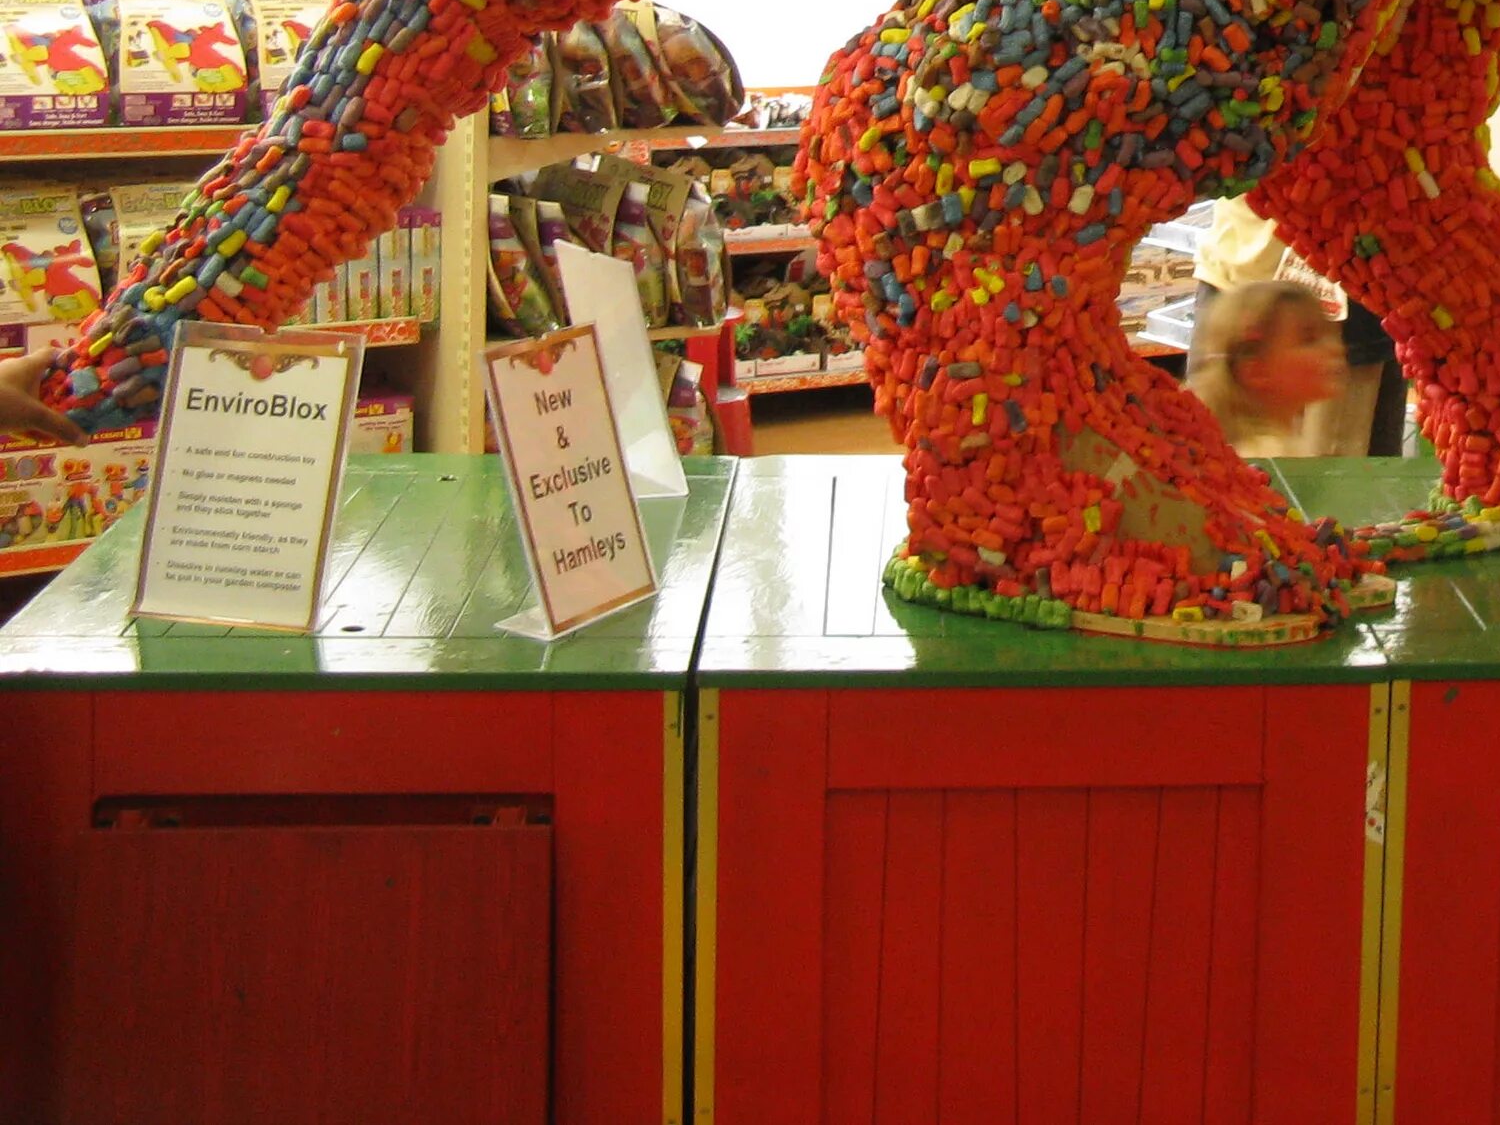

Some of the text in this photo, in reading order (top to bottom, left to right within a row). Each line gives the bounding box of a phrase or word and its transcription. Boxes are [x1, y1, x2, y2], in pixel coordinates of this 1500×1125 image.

[186, 387, 328, 421] EnviroBlox
[534, 387, 572, 416] New
[556, 425, 570, 449] &
[529, 457, 612, 501] Exclusive
[568, 500, 593, 527] To
[552, 531, 626, 575] Hamleys
